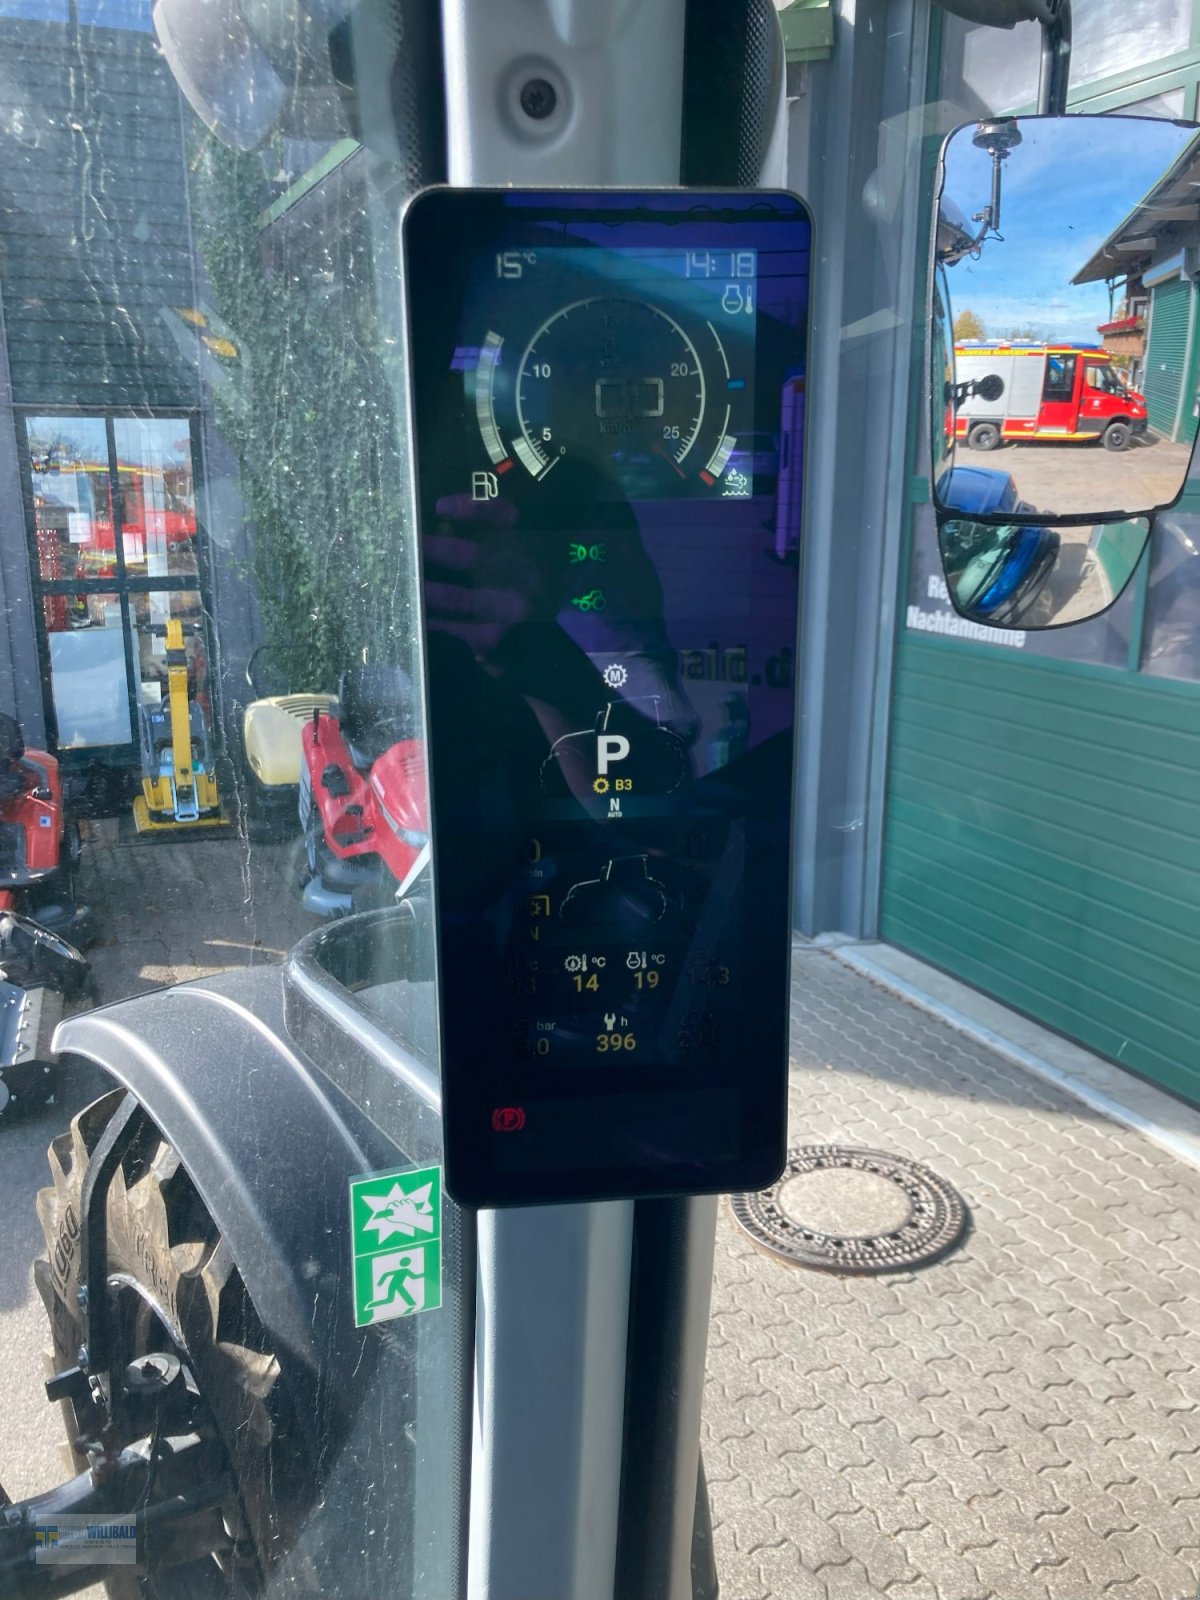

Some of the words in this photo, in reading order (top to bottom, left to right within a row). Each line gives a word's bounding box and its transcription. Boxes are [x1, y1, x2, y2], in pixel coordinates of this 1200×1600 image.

[685, 251, 755, 278] 14:18
[532, 364, 551, 378] 10
[670, 363, 689, 377] 20
[542, 428, 552, 442] 5
[662, 426, 680, 440] 25
[927, 575, 952, 606] Re
[597, 735, 630, 775] P
[615, 779, 633, 791] B3
[610, 798, 620, 812] N
[591, 957, 606, 969] °C
[651, 954, 666, 966] °C
[573, 973, 600, 992] 14
[633, 971, 660, 990] 19
[536, 1021, 556, 1032] bar
[620, 1016, 628, 1027] h
[596, 1033, 637, 1053] 396
